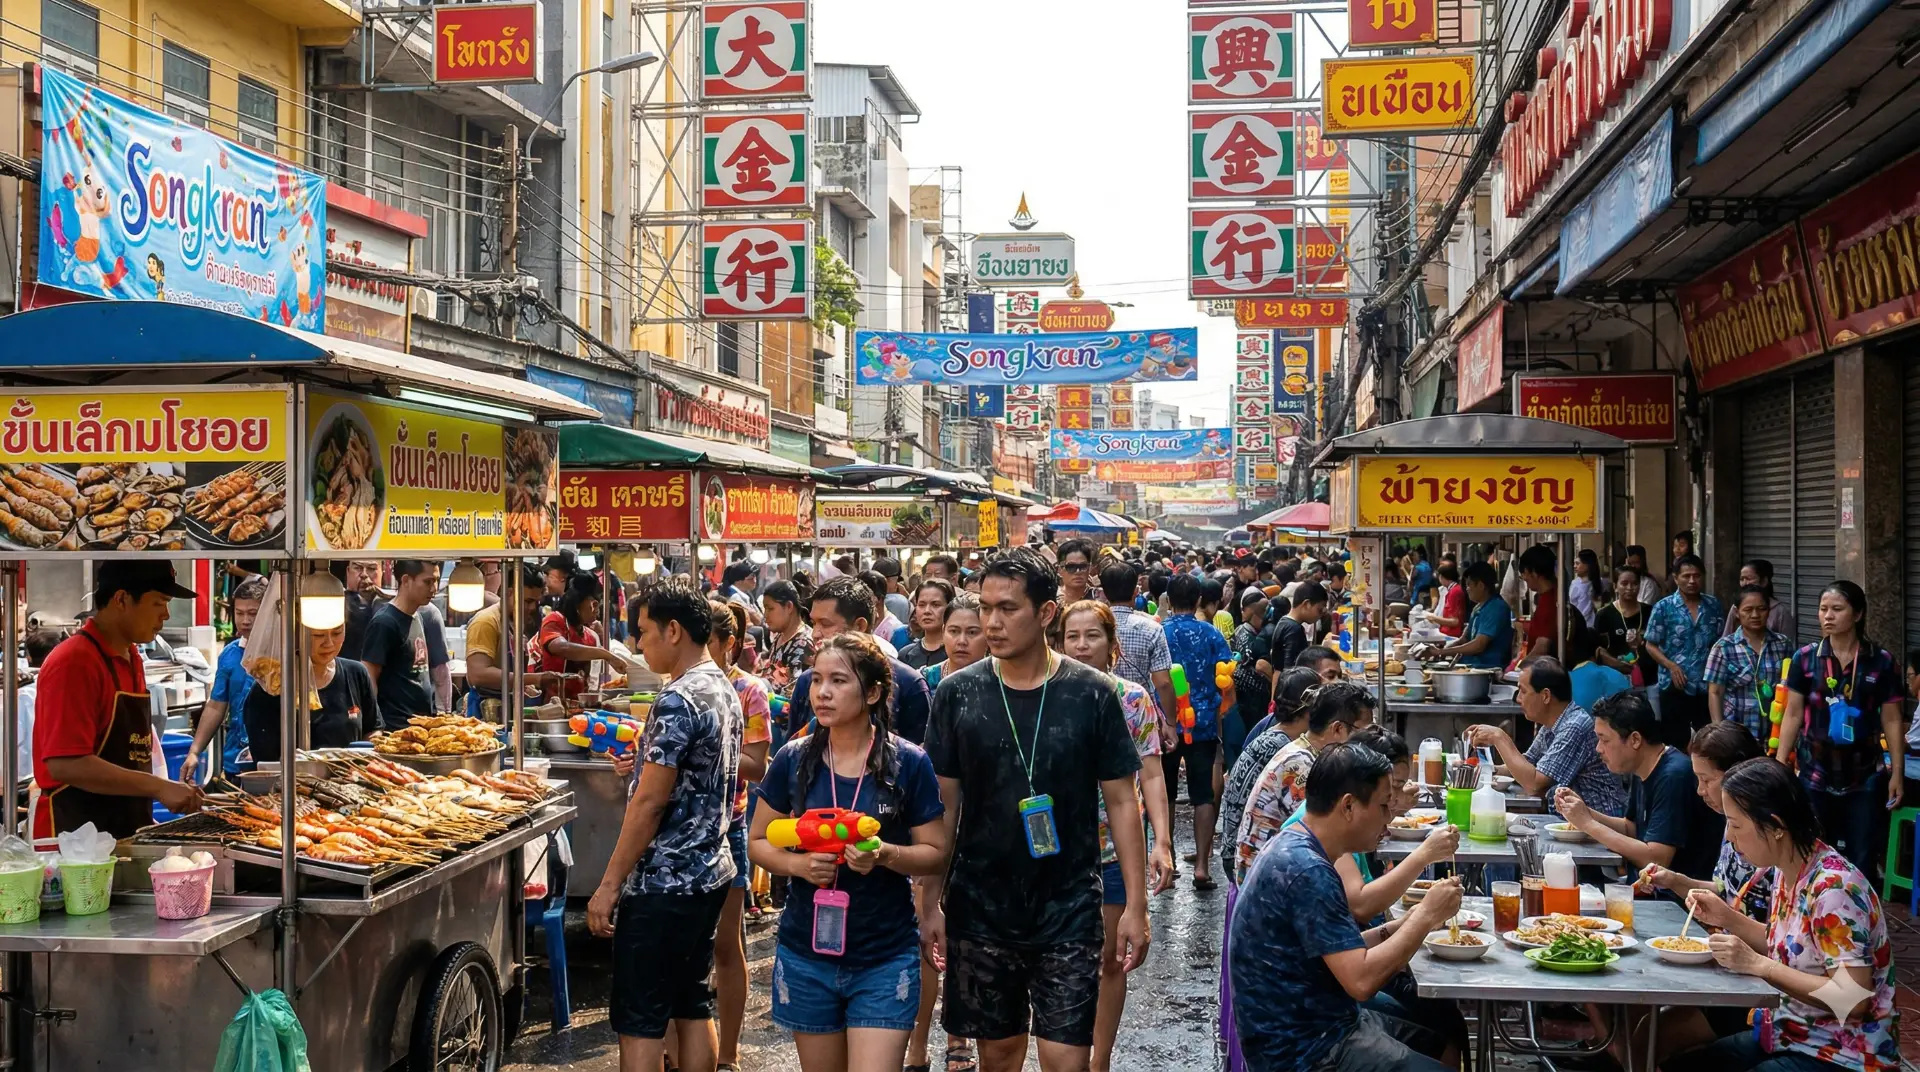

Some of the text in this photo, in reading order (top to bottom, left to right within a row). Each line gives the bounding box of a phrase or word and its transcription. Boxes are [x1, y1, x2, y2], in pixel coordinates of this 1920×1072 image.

[724, 15, 787, 77] 大
[722, 126, 790, 193] 金
[1210, 121, 1278, 185] 金
[120, 141, 277, 265] Songkran
[722, 238, 788, 304] 行
[1210, 220, 1276, 284] 行
[943, 340, 1120, 379] Songkran
[1096, 432, 1189, 457] Songkran
